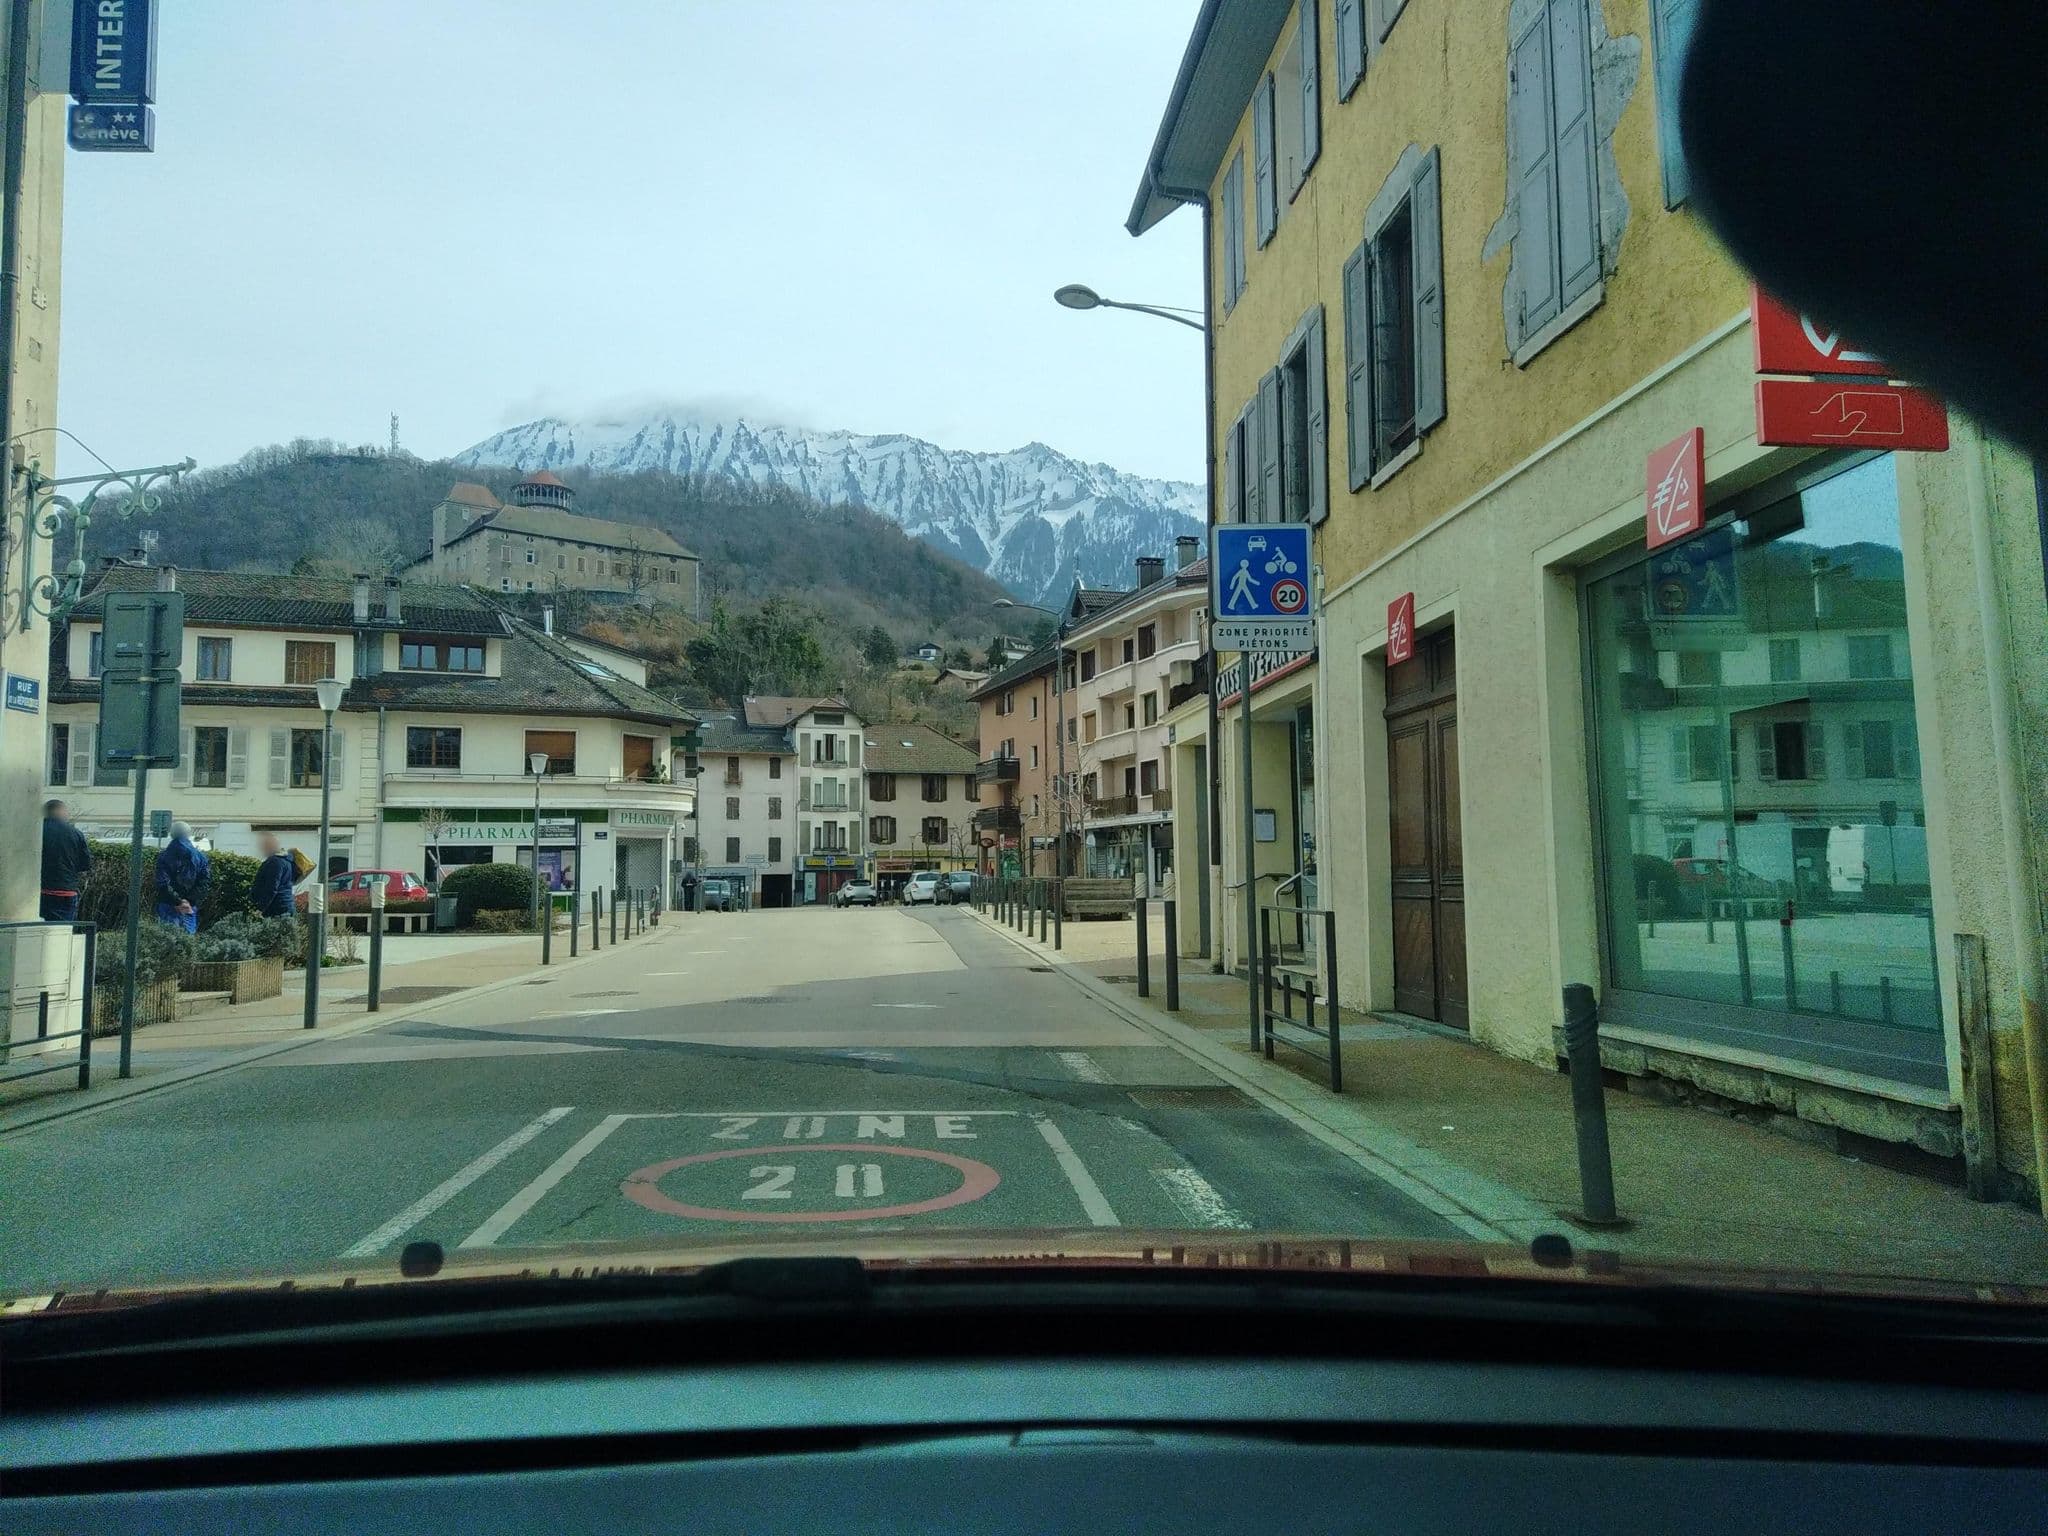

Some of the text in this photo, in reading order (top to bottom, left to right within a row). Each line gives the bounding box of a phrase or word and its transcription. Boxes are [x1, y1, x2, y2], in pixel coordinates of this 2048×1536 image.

[1279, 590, 1299, 603] 20
[1218, 626, 1309, 637] ZONE PRIORITÉ
[1239, 638, 1289, 648] PIÉTONS
[17, 681, 33, 693] RUE
[710, 1115, 978, 1140] ZONE
[741, 1163, 884, 1200] 20
